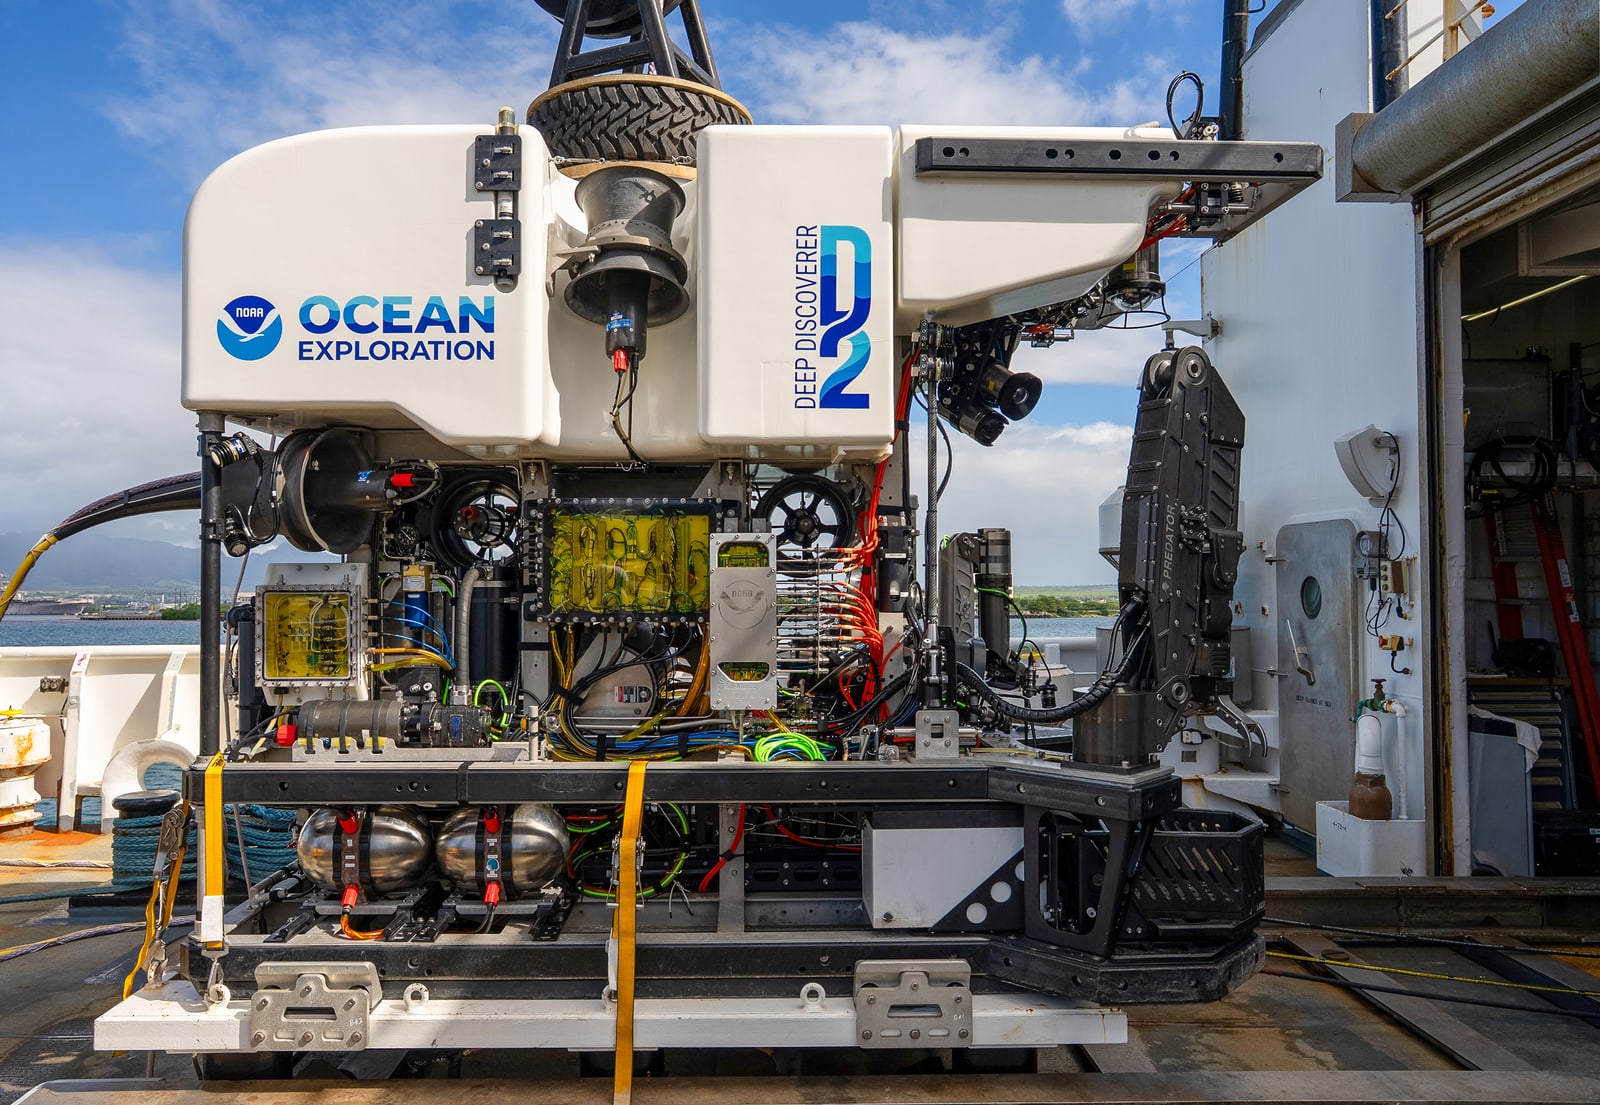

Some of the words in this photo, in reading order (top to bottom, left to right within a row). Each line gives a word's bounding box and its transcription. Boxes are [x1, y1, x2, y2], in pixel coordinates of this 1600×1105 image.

[795, 225, 818, 351] DISCOVERER
[236, 307, 264, 318] NOAA
[298, 296, 495, 334] OCEAN
[298, 340, 495, 361] EXPLORATION
[794, 357, 817, 409] DEEP
[1163, 505, 1176, 579] PREDATOR
